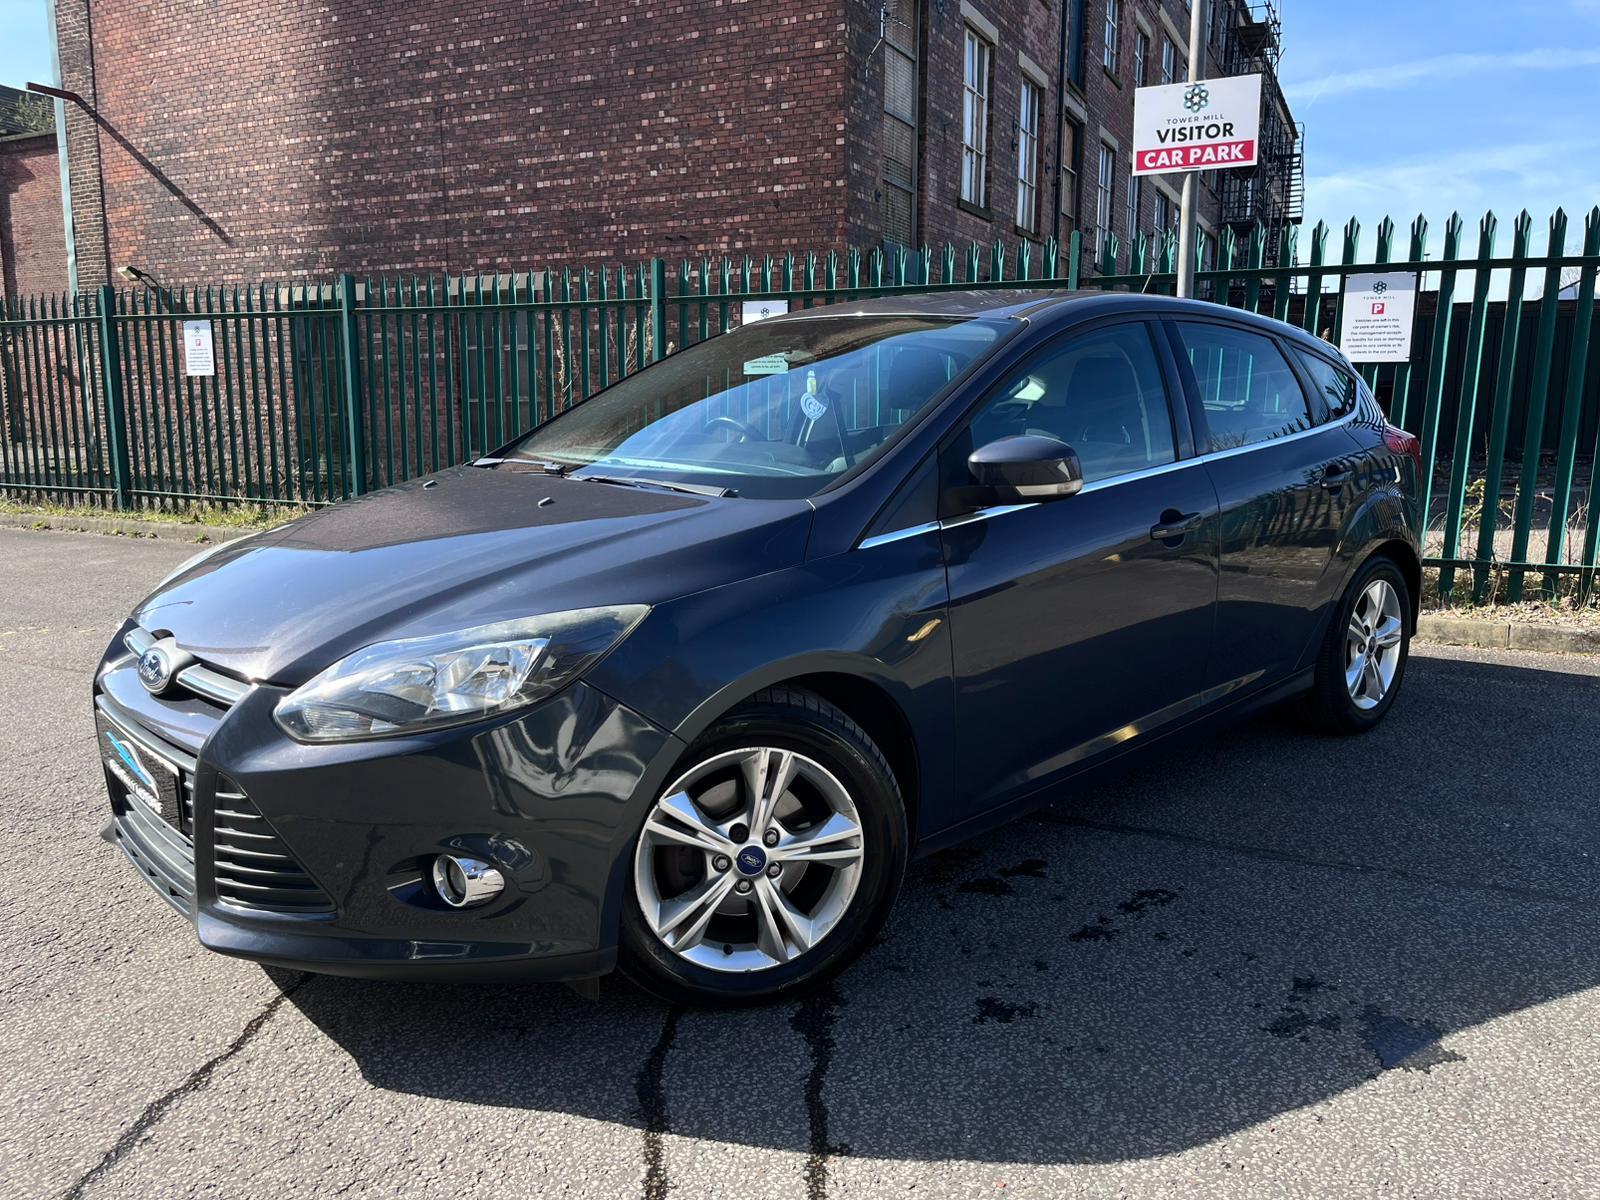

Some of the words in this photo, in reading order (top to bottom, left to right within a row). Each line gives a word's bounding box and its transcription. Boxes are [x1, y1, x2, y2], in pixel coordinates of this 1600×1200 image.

[1167, 116, 1199, 125] TOWER
[1156, 122, 1234, 144] VISITOR
[1144, 150, 1183, 168] CAR
[1189, 143, 1244, 163] PARK
[1374, 304, 1382, 314] P
[140, 655, 161, 681] Ford
